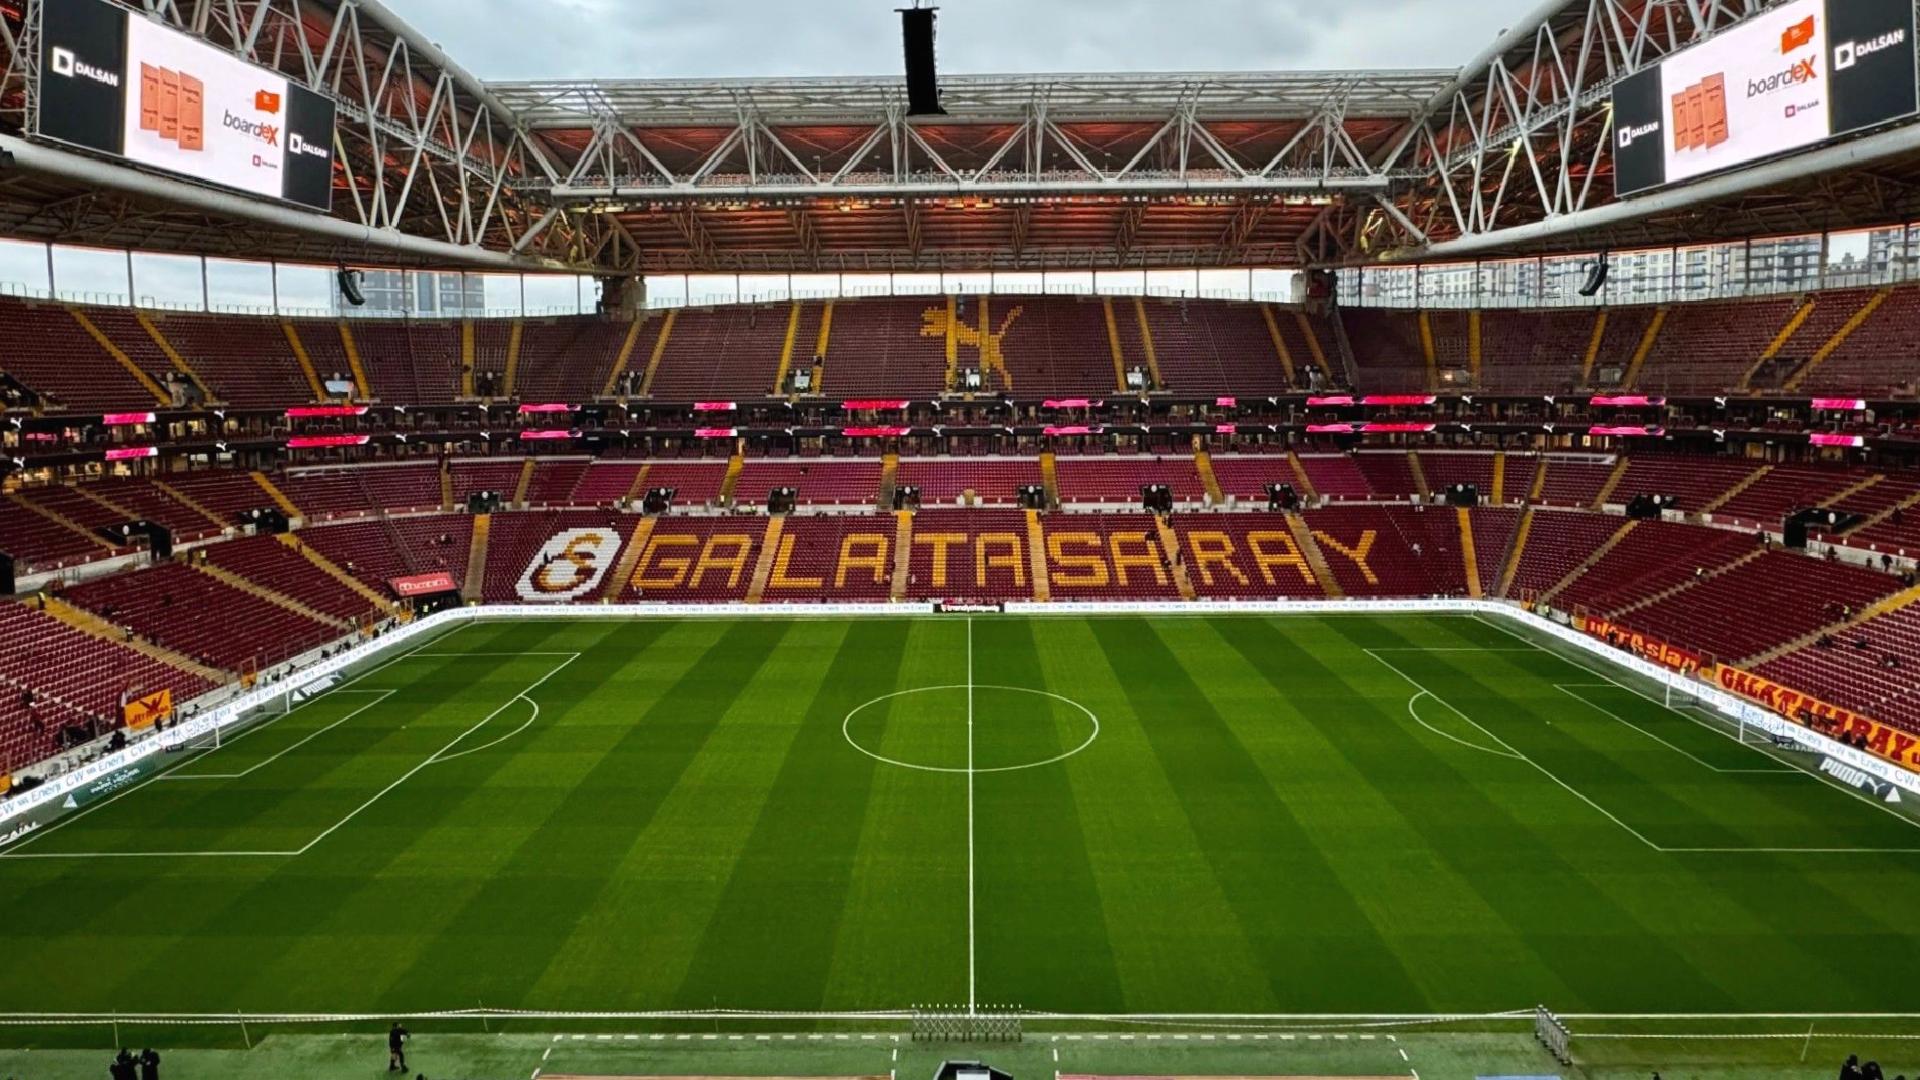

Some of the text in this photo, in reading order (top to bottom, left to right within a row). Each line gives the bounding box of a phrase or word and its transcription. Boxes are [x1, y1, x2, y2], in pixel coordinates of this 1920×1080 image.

[1856, 29, 1904, 57] DALSAN
[76, 62, 118, 87] DALSAN
[1631, 121, 1659, 138] DALSAN
[302, 143, 327, 158] DALSAN
[632, 530, 1378, 589] GALATASARAY
[1820, 756, 1867, 788] PUMA
